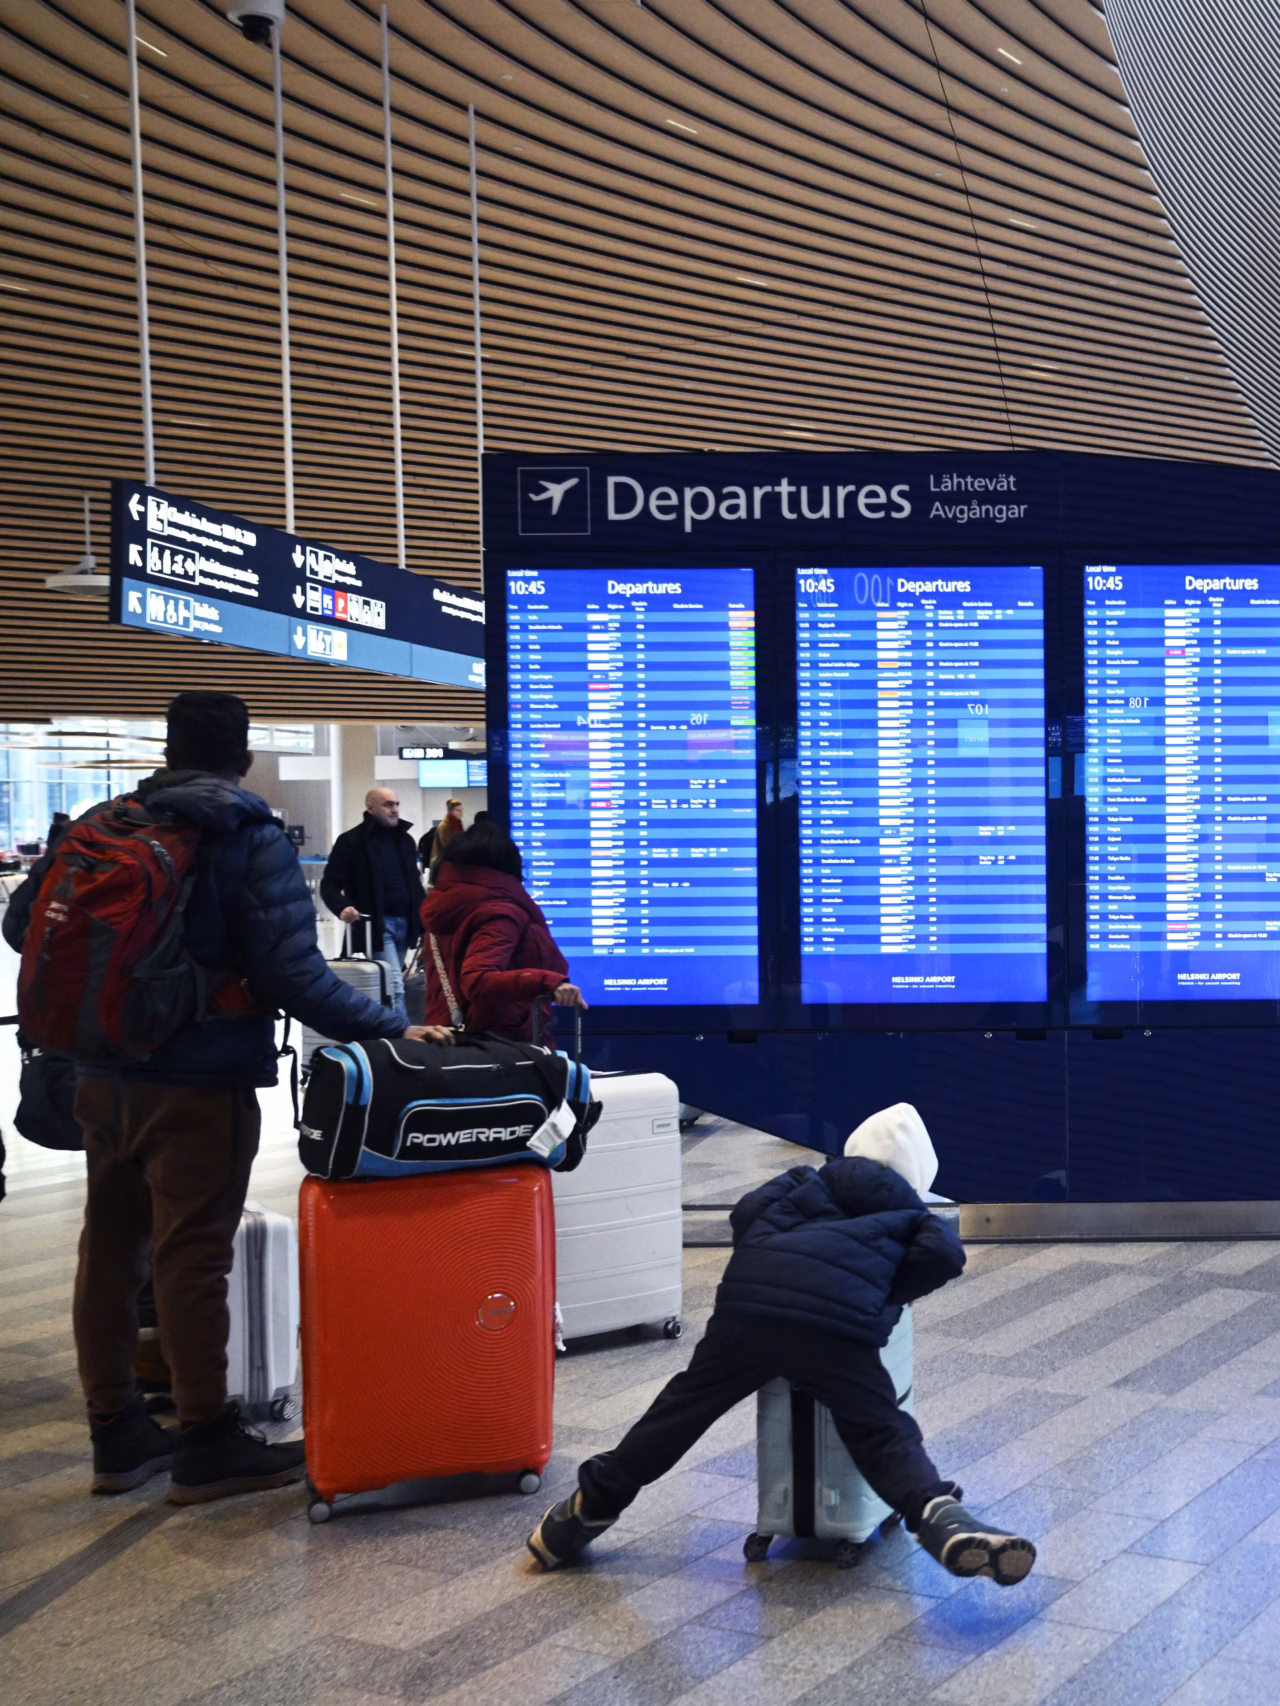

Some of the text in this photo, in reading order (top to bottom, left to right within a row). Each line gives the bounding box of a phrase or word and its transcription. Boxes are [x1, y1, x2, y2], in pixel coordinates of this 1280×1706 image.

[930, 473, 1017, 491] Lähtevät
[606, 475, 912, 533] Departures
[930, 499, 1029, 524] Avgångar
[509, 581, 545, 594] 10:45
[608, 580, 682, 597] Departures
[799, 579, 834, 593] 10:45
[898, 578, 971, 595] Departures
[1087, 576, 1122, 590] 10:45
[1186, 576, 1258, 593] Departures
[602, 978, 669, 986] HELSINKI AIRPORT
[1177, 973, 1241, 981] HELSINKI AIRPORT
[406, 1124, 534, 1147] POWERADE
